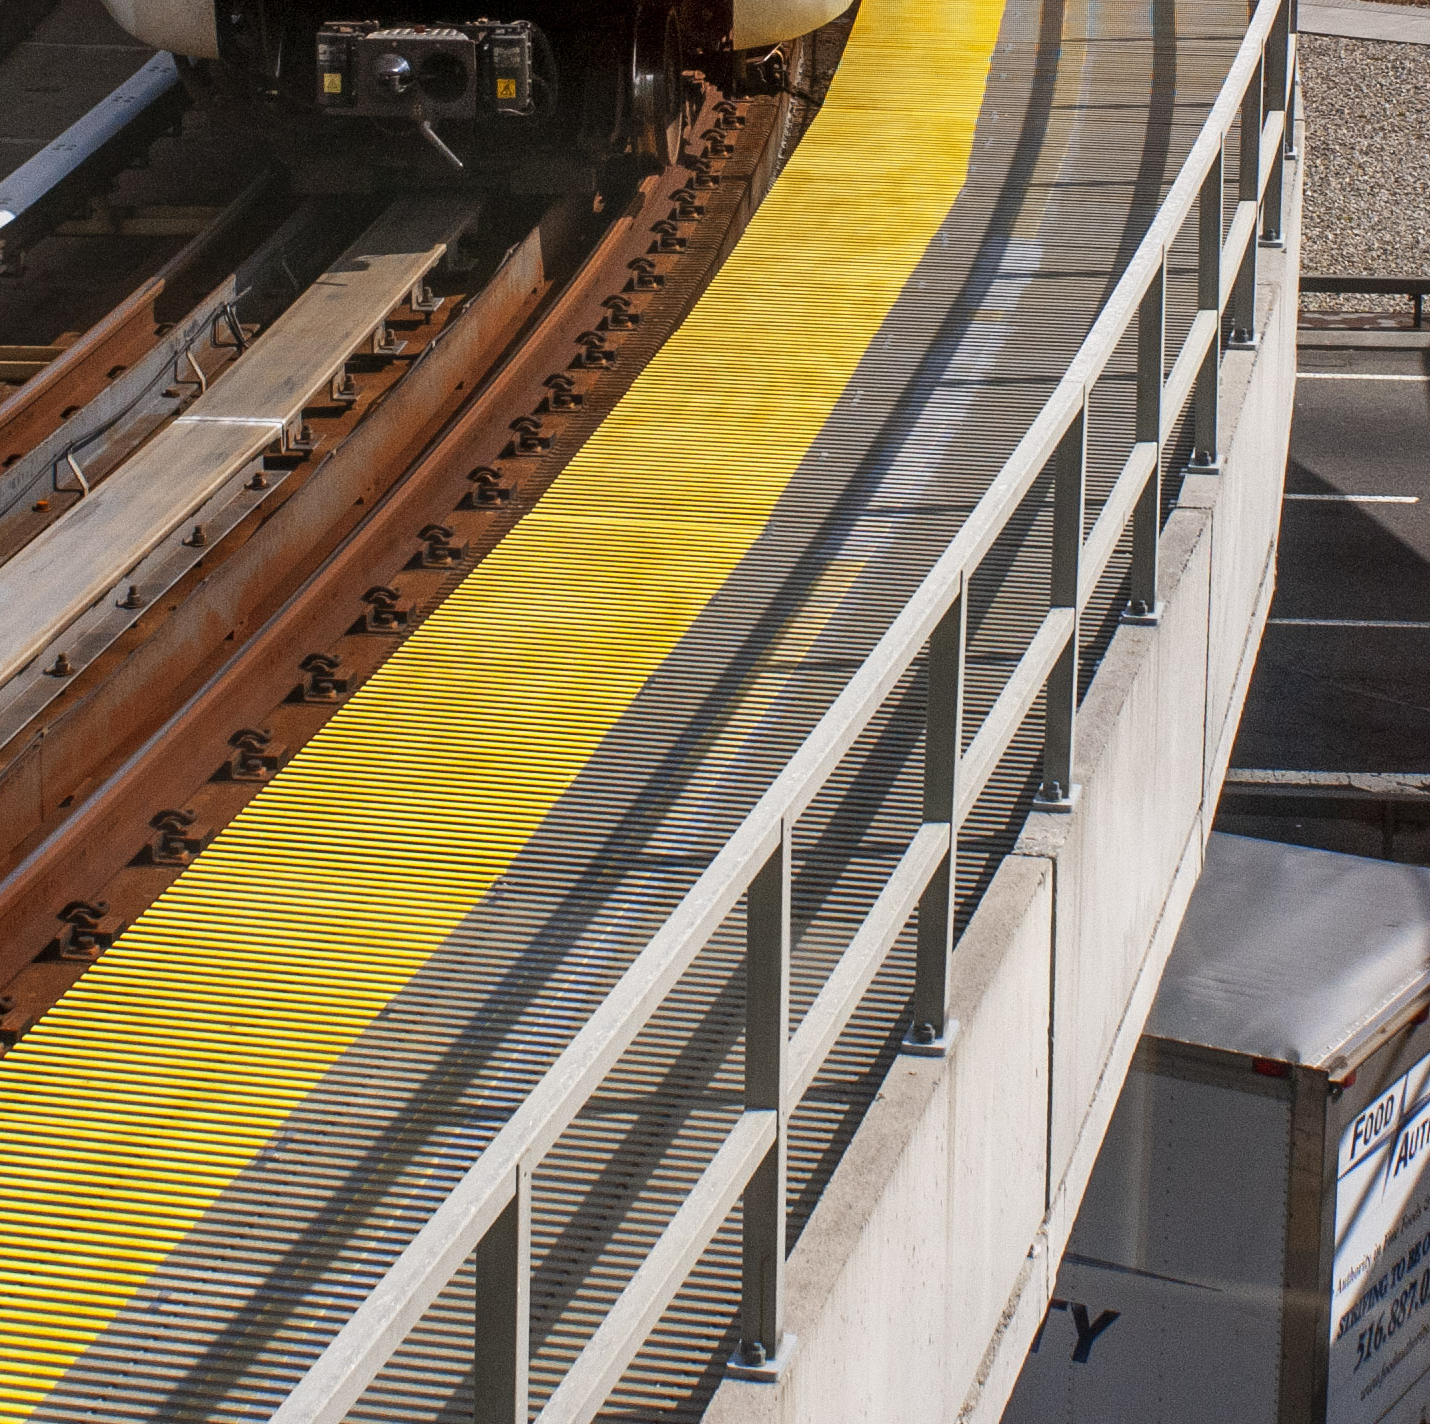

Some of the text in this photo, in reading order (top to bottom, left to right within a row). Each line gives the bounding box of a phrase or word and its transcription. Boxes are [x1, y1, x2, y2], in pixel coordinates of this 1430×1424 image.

[1349, 1094, 1395, 1161] FOOD
[1390, 1255, 1406, 1288] TO
[1407, 1239, 1423, 1274] BE
